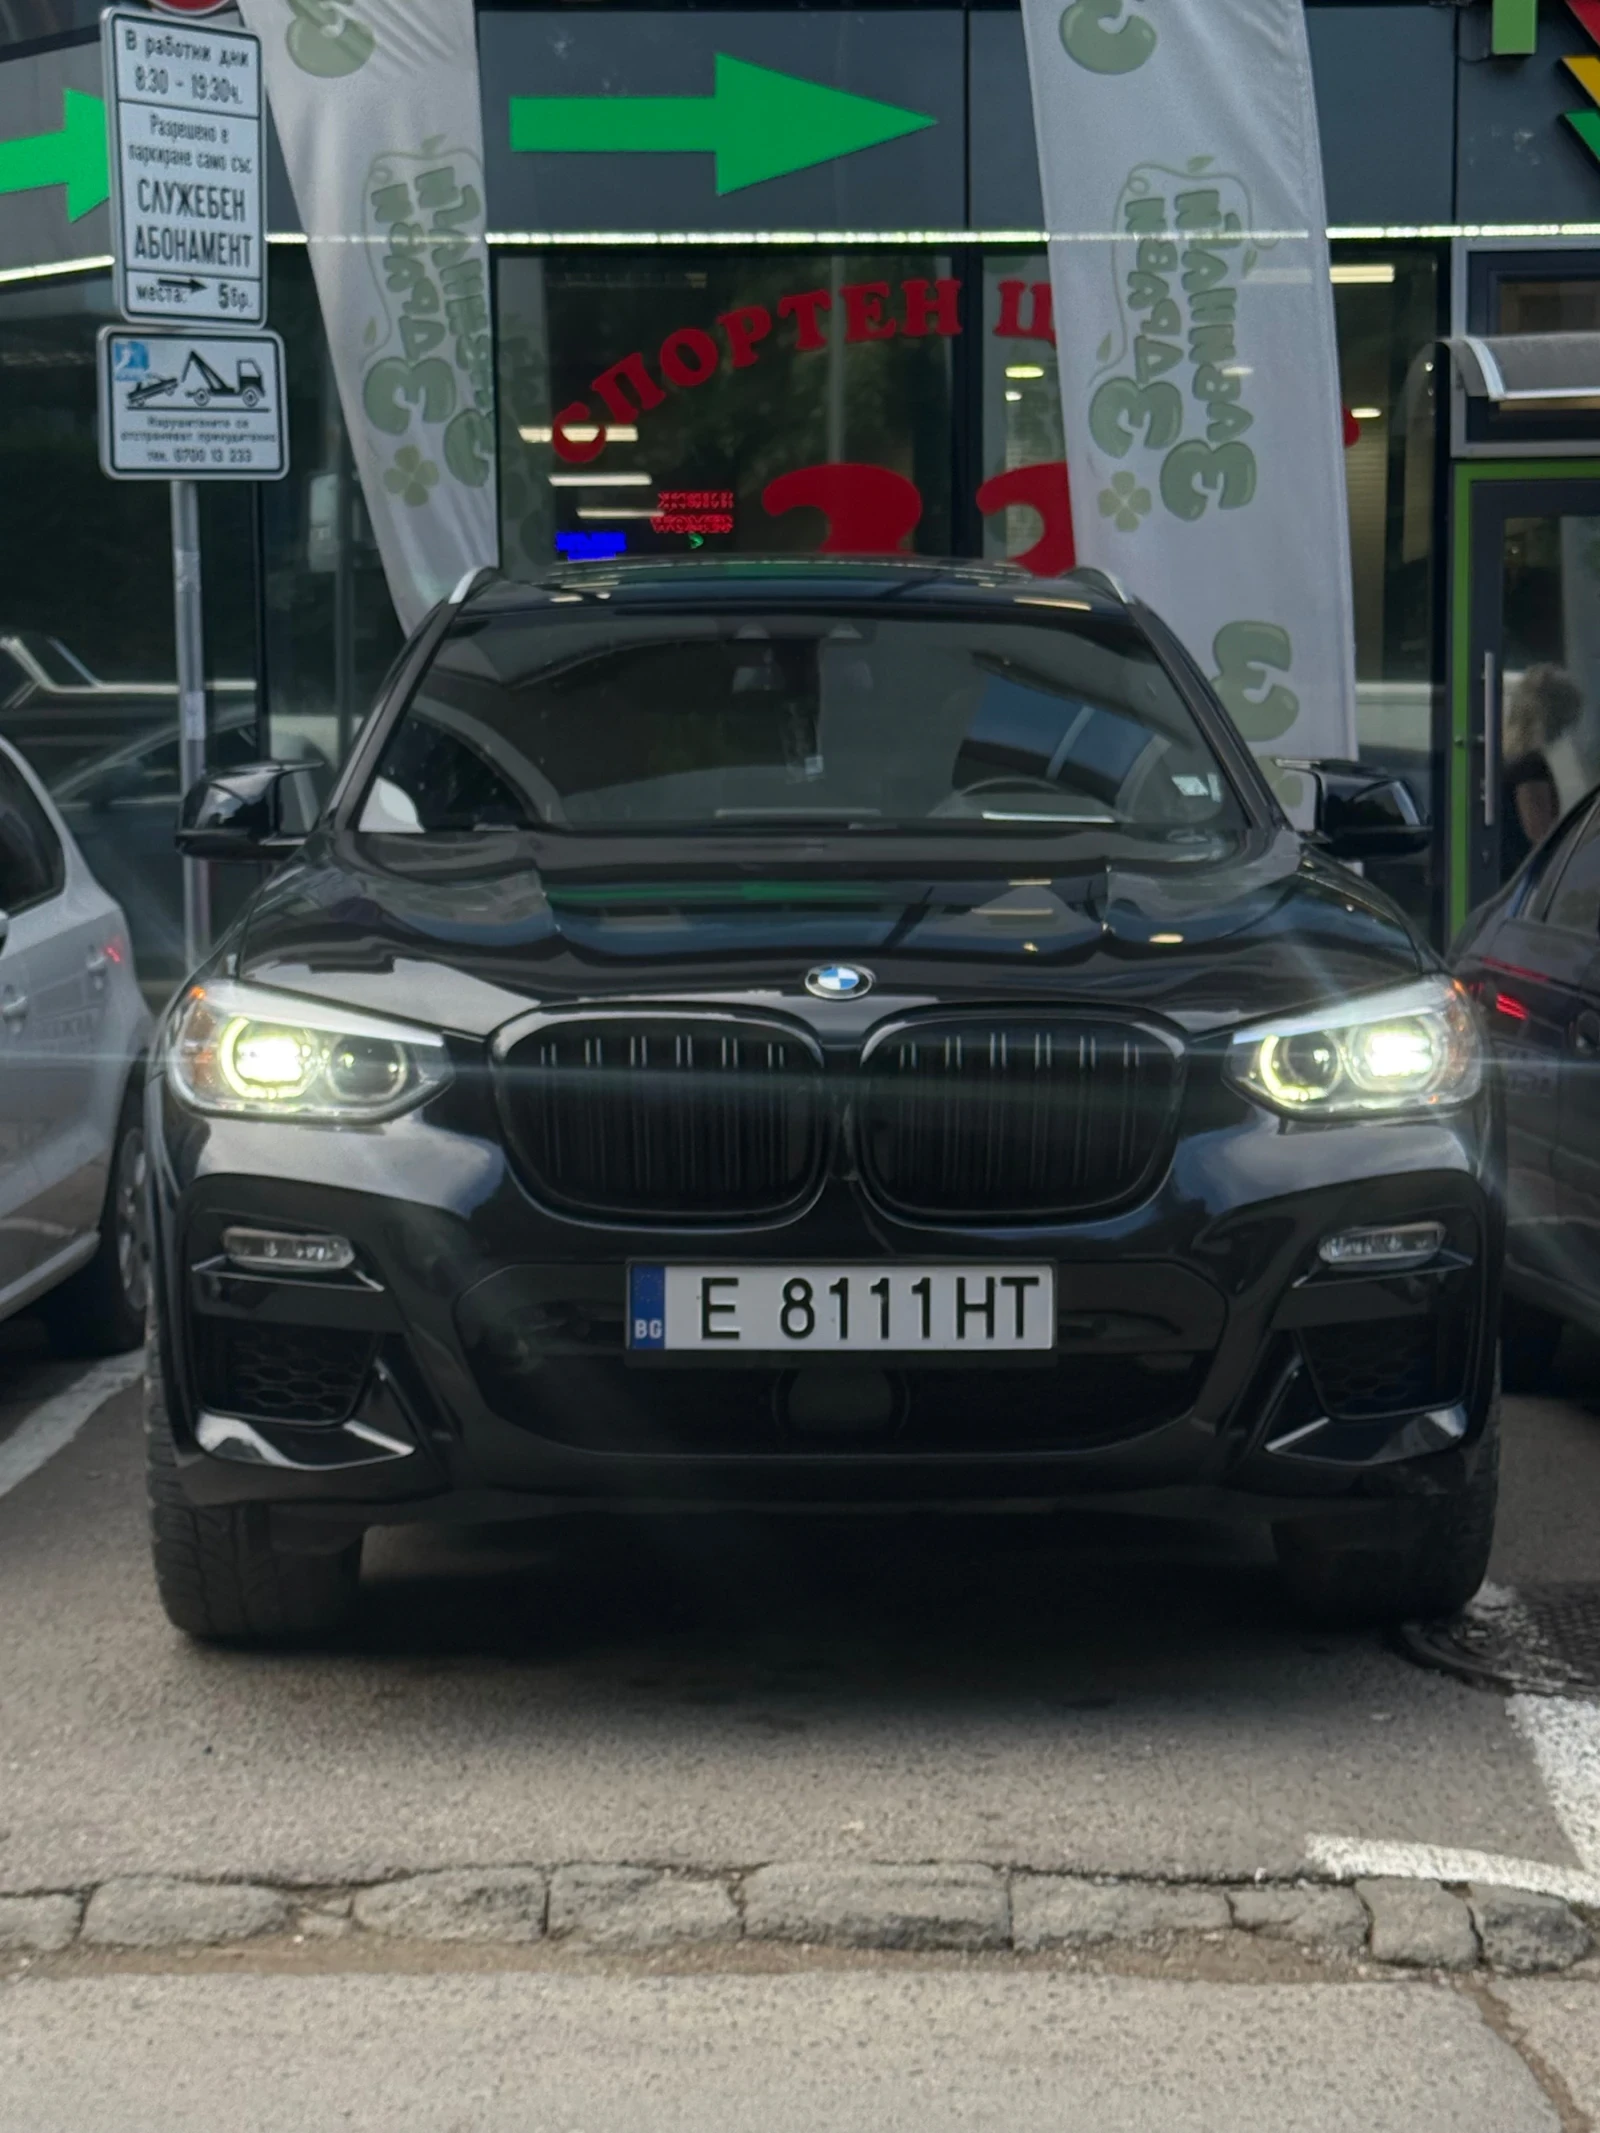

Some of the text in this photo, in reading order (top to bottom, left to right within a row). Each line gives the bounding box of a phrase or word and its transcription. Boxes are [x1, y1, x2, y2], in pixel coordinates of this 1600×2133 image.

[125, 29, 249, 68] В работни дни
[150, 112, 229, 144] Разрешено е
[128, 144, 253, 173] паркиране само със
[137, 178, 245, 222] СЛУЖЕБЕН
[134, 223, 253, 268] АБОНАМЕНТ
[552, 279, 963, 464] СПОРТЕН
[634, 1319, 662, 1339] BG
[702, 1277, 740, 1340] E
